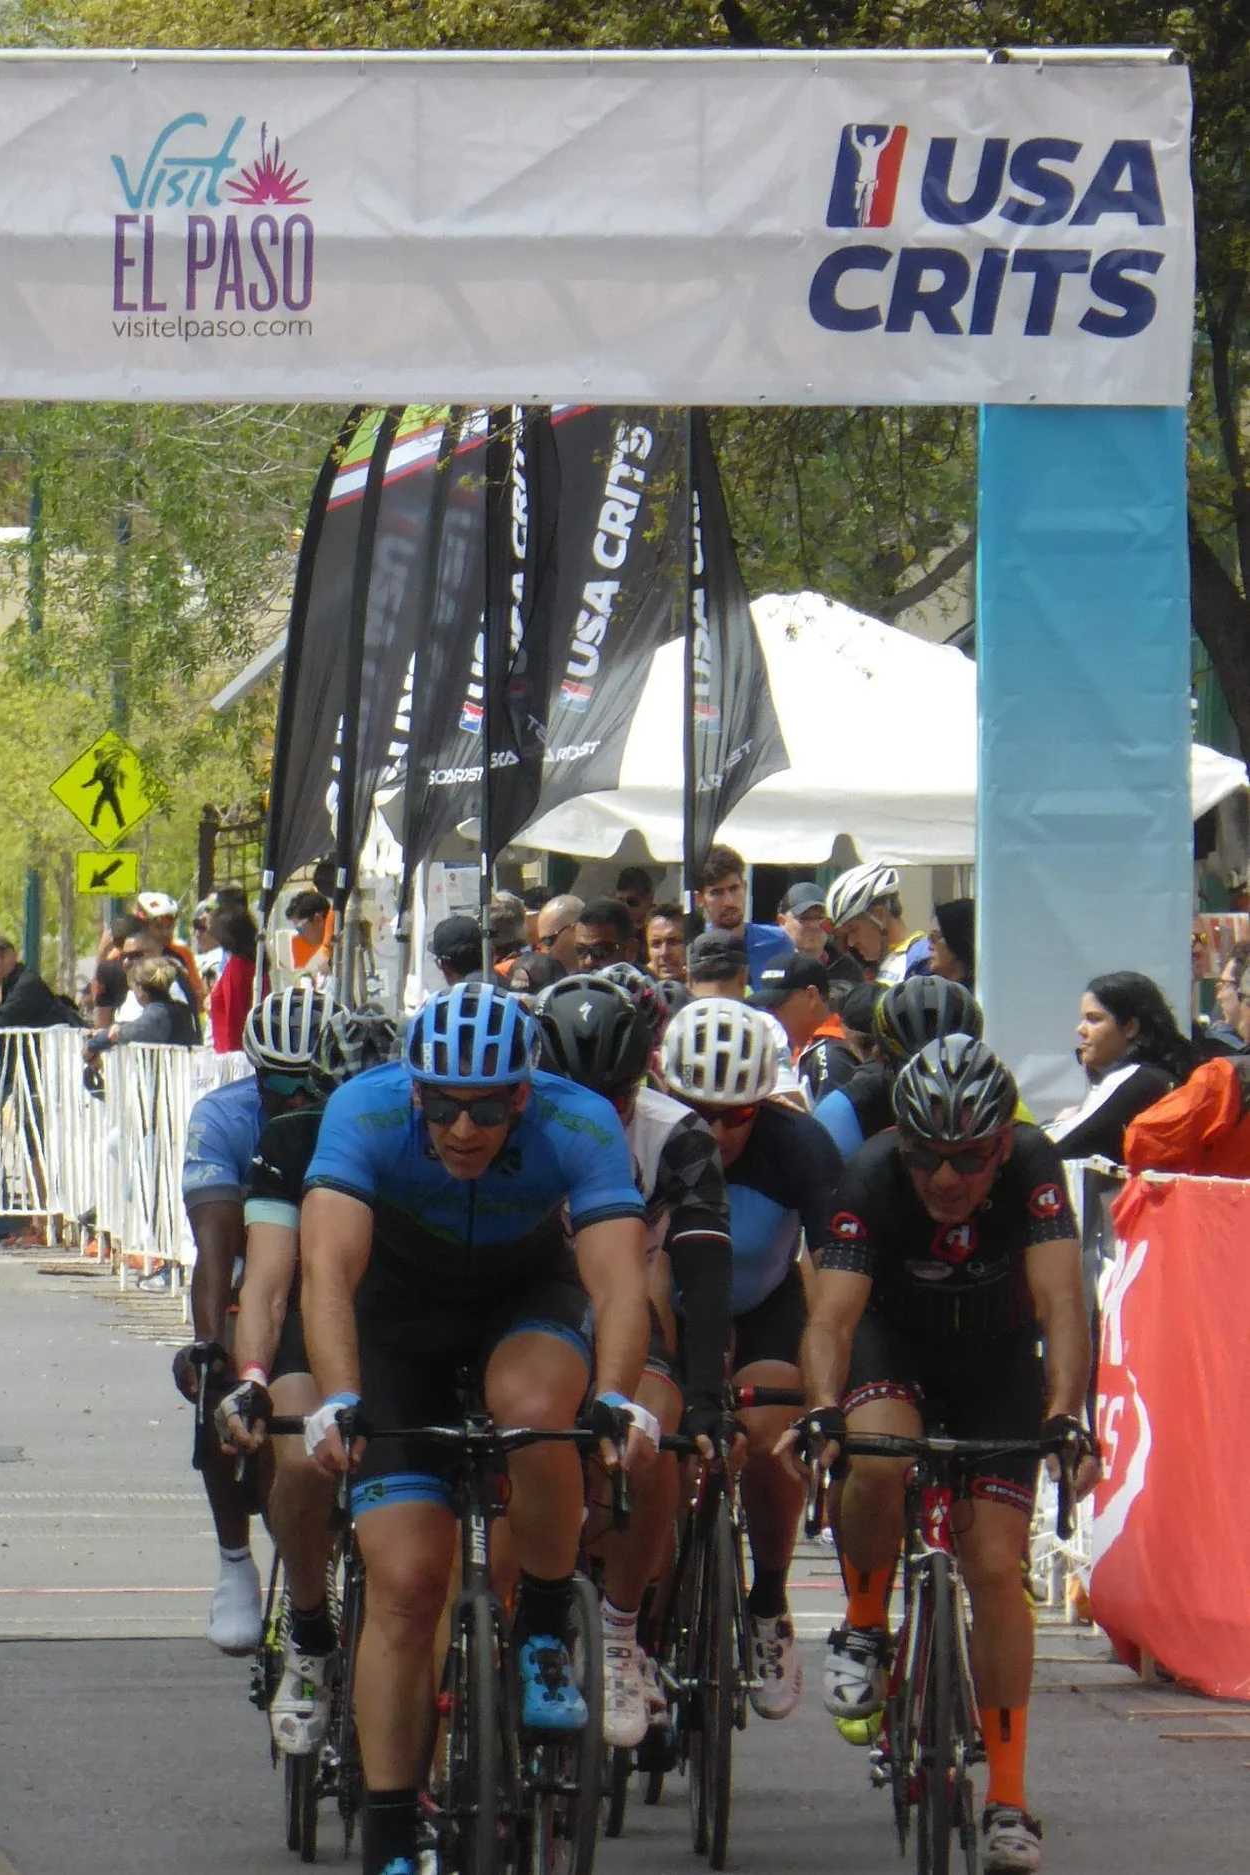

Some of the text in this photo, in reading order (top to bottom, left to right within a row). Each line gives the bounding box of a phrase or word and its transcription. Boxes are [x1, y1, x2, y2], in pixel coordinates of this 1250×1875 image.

[110, 112, 247, 209] Visit
[921, 137, 1165, 226] USA
[113, 213, 314, 312] EL PASO
[808, 245, 1165, 338] CRITS
[111, 315, 314, 342] visitelpaso.com
[566, 581, 620, 678] USA
[471, 1514, 486, 1565] BMC
